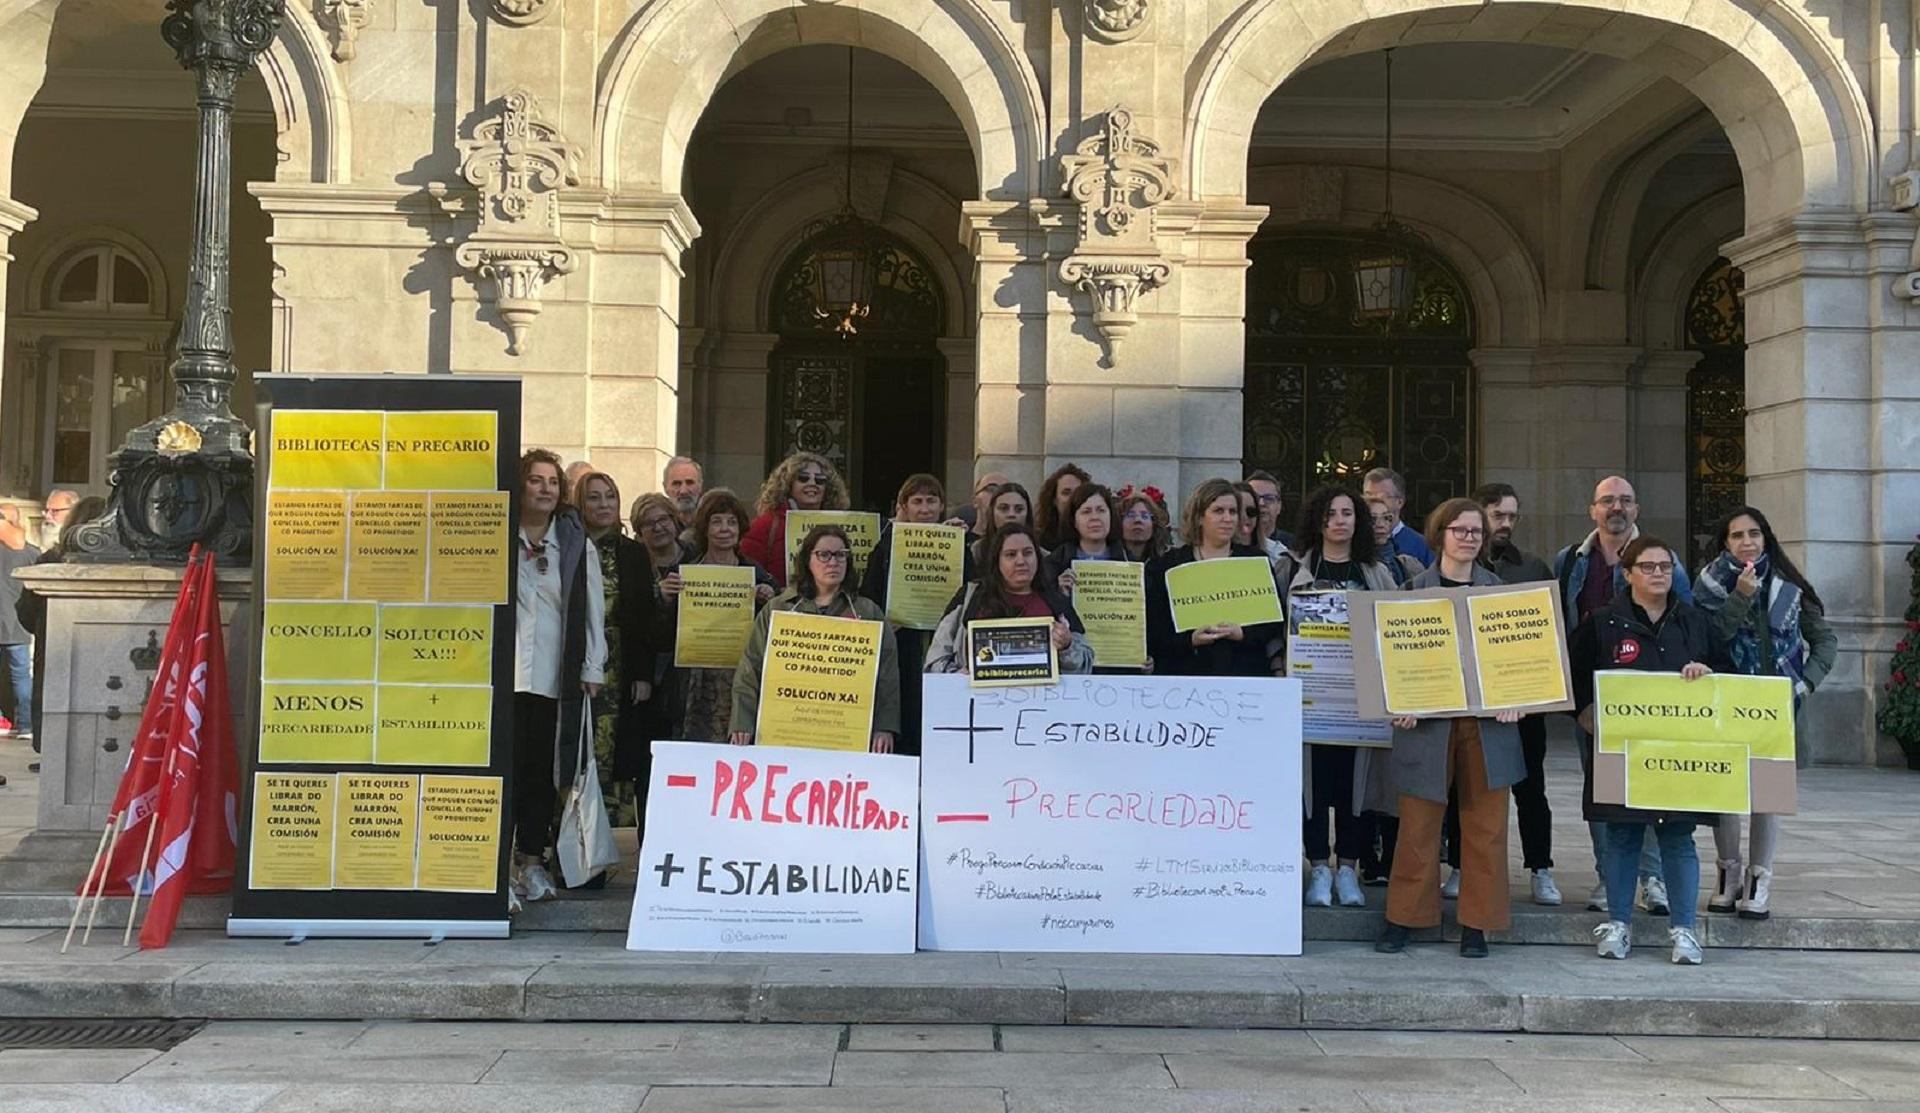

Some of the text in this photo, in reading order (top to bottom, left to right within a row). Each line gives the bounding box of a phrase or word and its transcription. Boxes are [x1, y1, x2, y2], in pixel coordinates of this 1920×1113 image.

[277, 439, 490, 451] BIBLIOTECAS EN PRECARIO
[925, 530, 956, 539] QUERES
[277, 547, 338, 555] SOLUCIÓN XA!
[358, 547, 418, 555] SOLUCIÓN XA!
[438, 547, 499, 555] SOLUCIÓN XA!
[905, 574, 946, 583] COMISIÓN
[1172, 587, 1275, 606] PRECARIEDADE
[1482, 608, 1540, 621] NON SOMOS
[1409, 616, 1442, 625] SOMOS
[1478, 618, 1549, 633] GASTO, SOMOS
[270, 625, 371, 638] CONCELLO
[385, 628, 484, 641] SOLUCIÓN
[780, 628, 822, 640] ESTAMOS
[823, 631, 857, 643] FARTAS
[1384, 628, 1451, 639] GASTO, SOMOS
[771, 639, 788, 647] QUE
[792, 641, 830, 651] XOGUEN
[832, 644, 852, 653] CON
[413, 649, 456, 660] XA!!!
[776, 651, 865, 666] CONCELLO, CUMPRE
[785, 663, 857, 677] CO PROMETIDO!
[273, 696, 363, 711] MENOS
[838, 693, 859, 704] XA!
[1605, 704, 1778, 720] CONCELLO NON
[263, 724, 374, 734] PRECARIEDADE
[381, 719, 486, 730] ESTABILIDADE
[1645, 758, 1732, 774] CUMPRE
[293, 780, 327, 788] QUERES
[373, 780, 410, 789] QUERES
[267, 817, 321, 825] CREA UNHA
[349, 817, 403, 825] CREA UNHA
[270, 829, 318, 838] COMISIÓN
[351, 829, 400, 838] COMISIÓN
[474, 834, 489, 842] XA!
[697, 856, 911, 896] ESTABILIDADE
